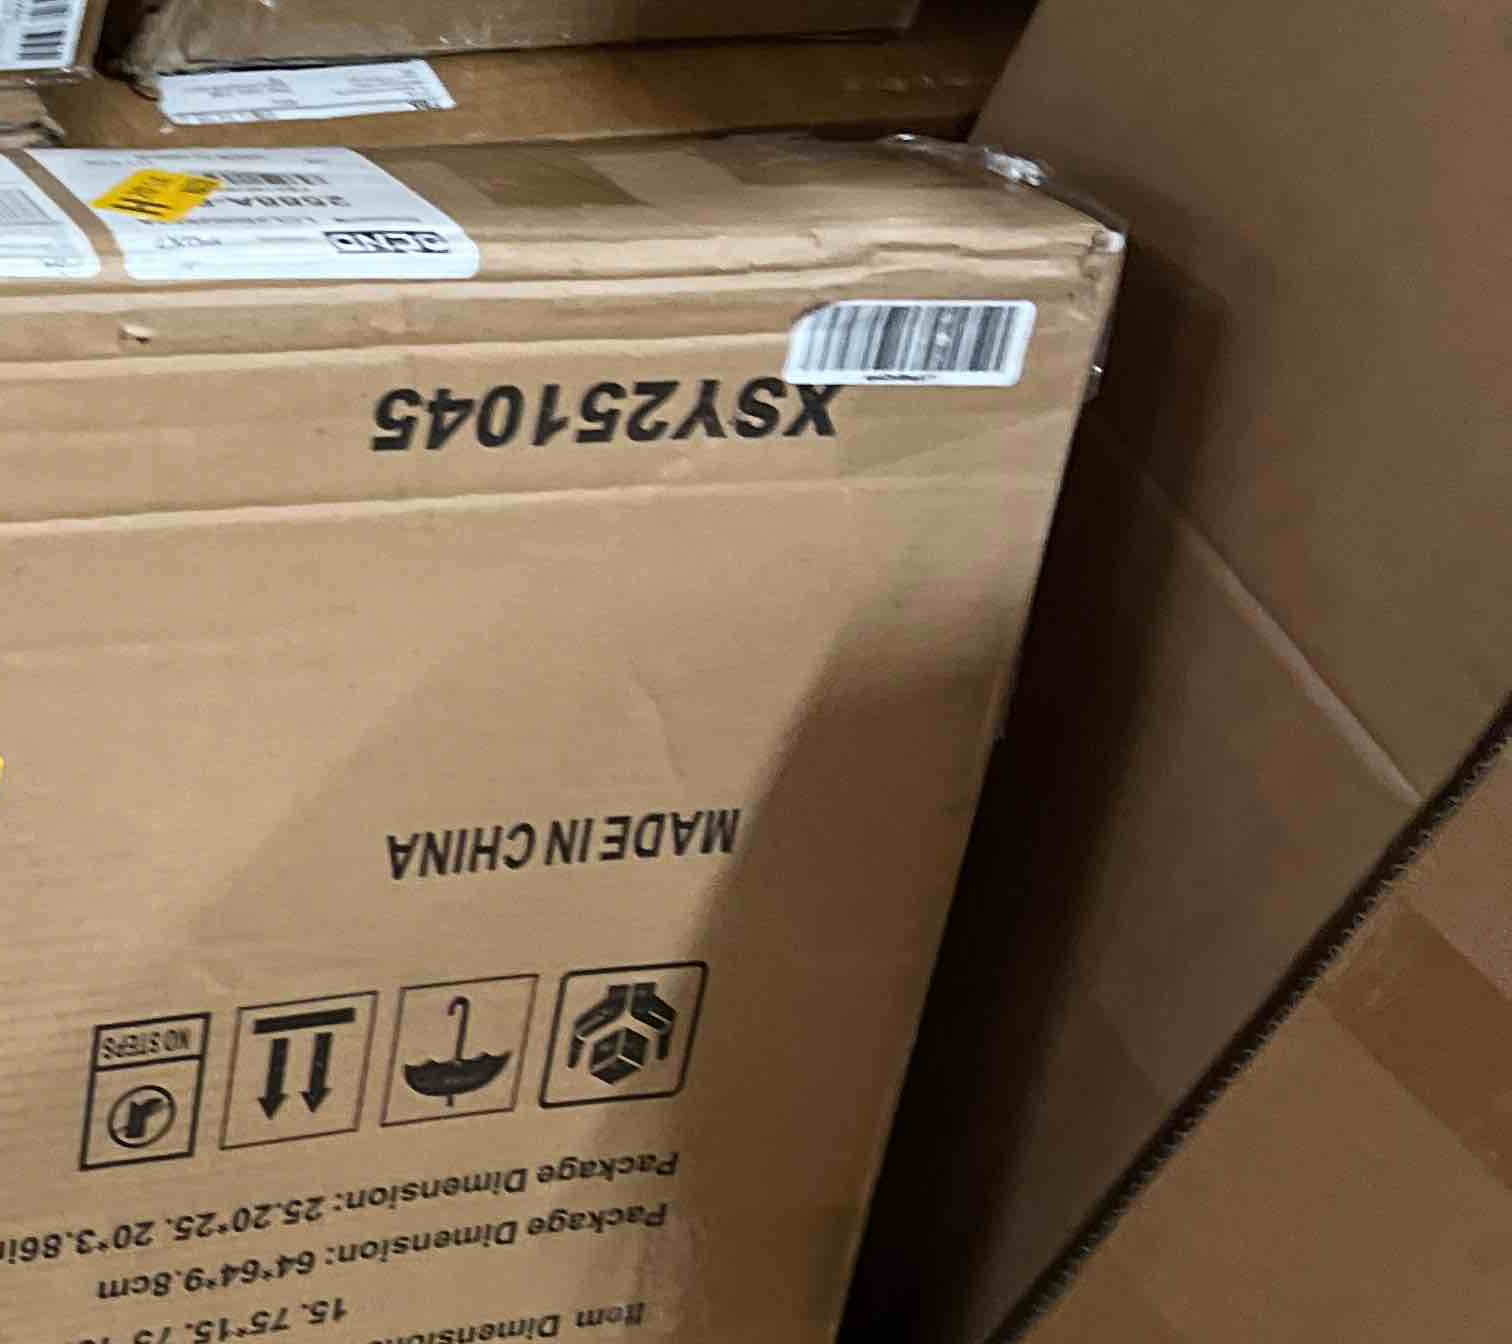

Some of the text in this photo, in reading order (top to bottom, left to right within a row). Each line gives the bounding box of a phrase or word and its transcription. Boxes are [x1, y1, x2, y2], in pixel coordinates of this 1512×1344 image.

[370, 376, 850, 452] XSY251045
[385, 807, 742, 880] MADE IN CHINA
[334, 1167, 528, 1213] Dimension:
[535, 1154, 681, 1185] Package
[527, 1201, 670, 1237] Package
[325, 1219, 519, 1267] Dimension:
[574, 1300, 648, 1330] Item
